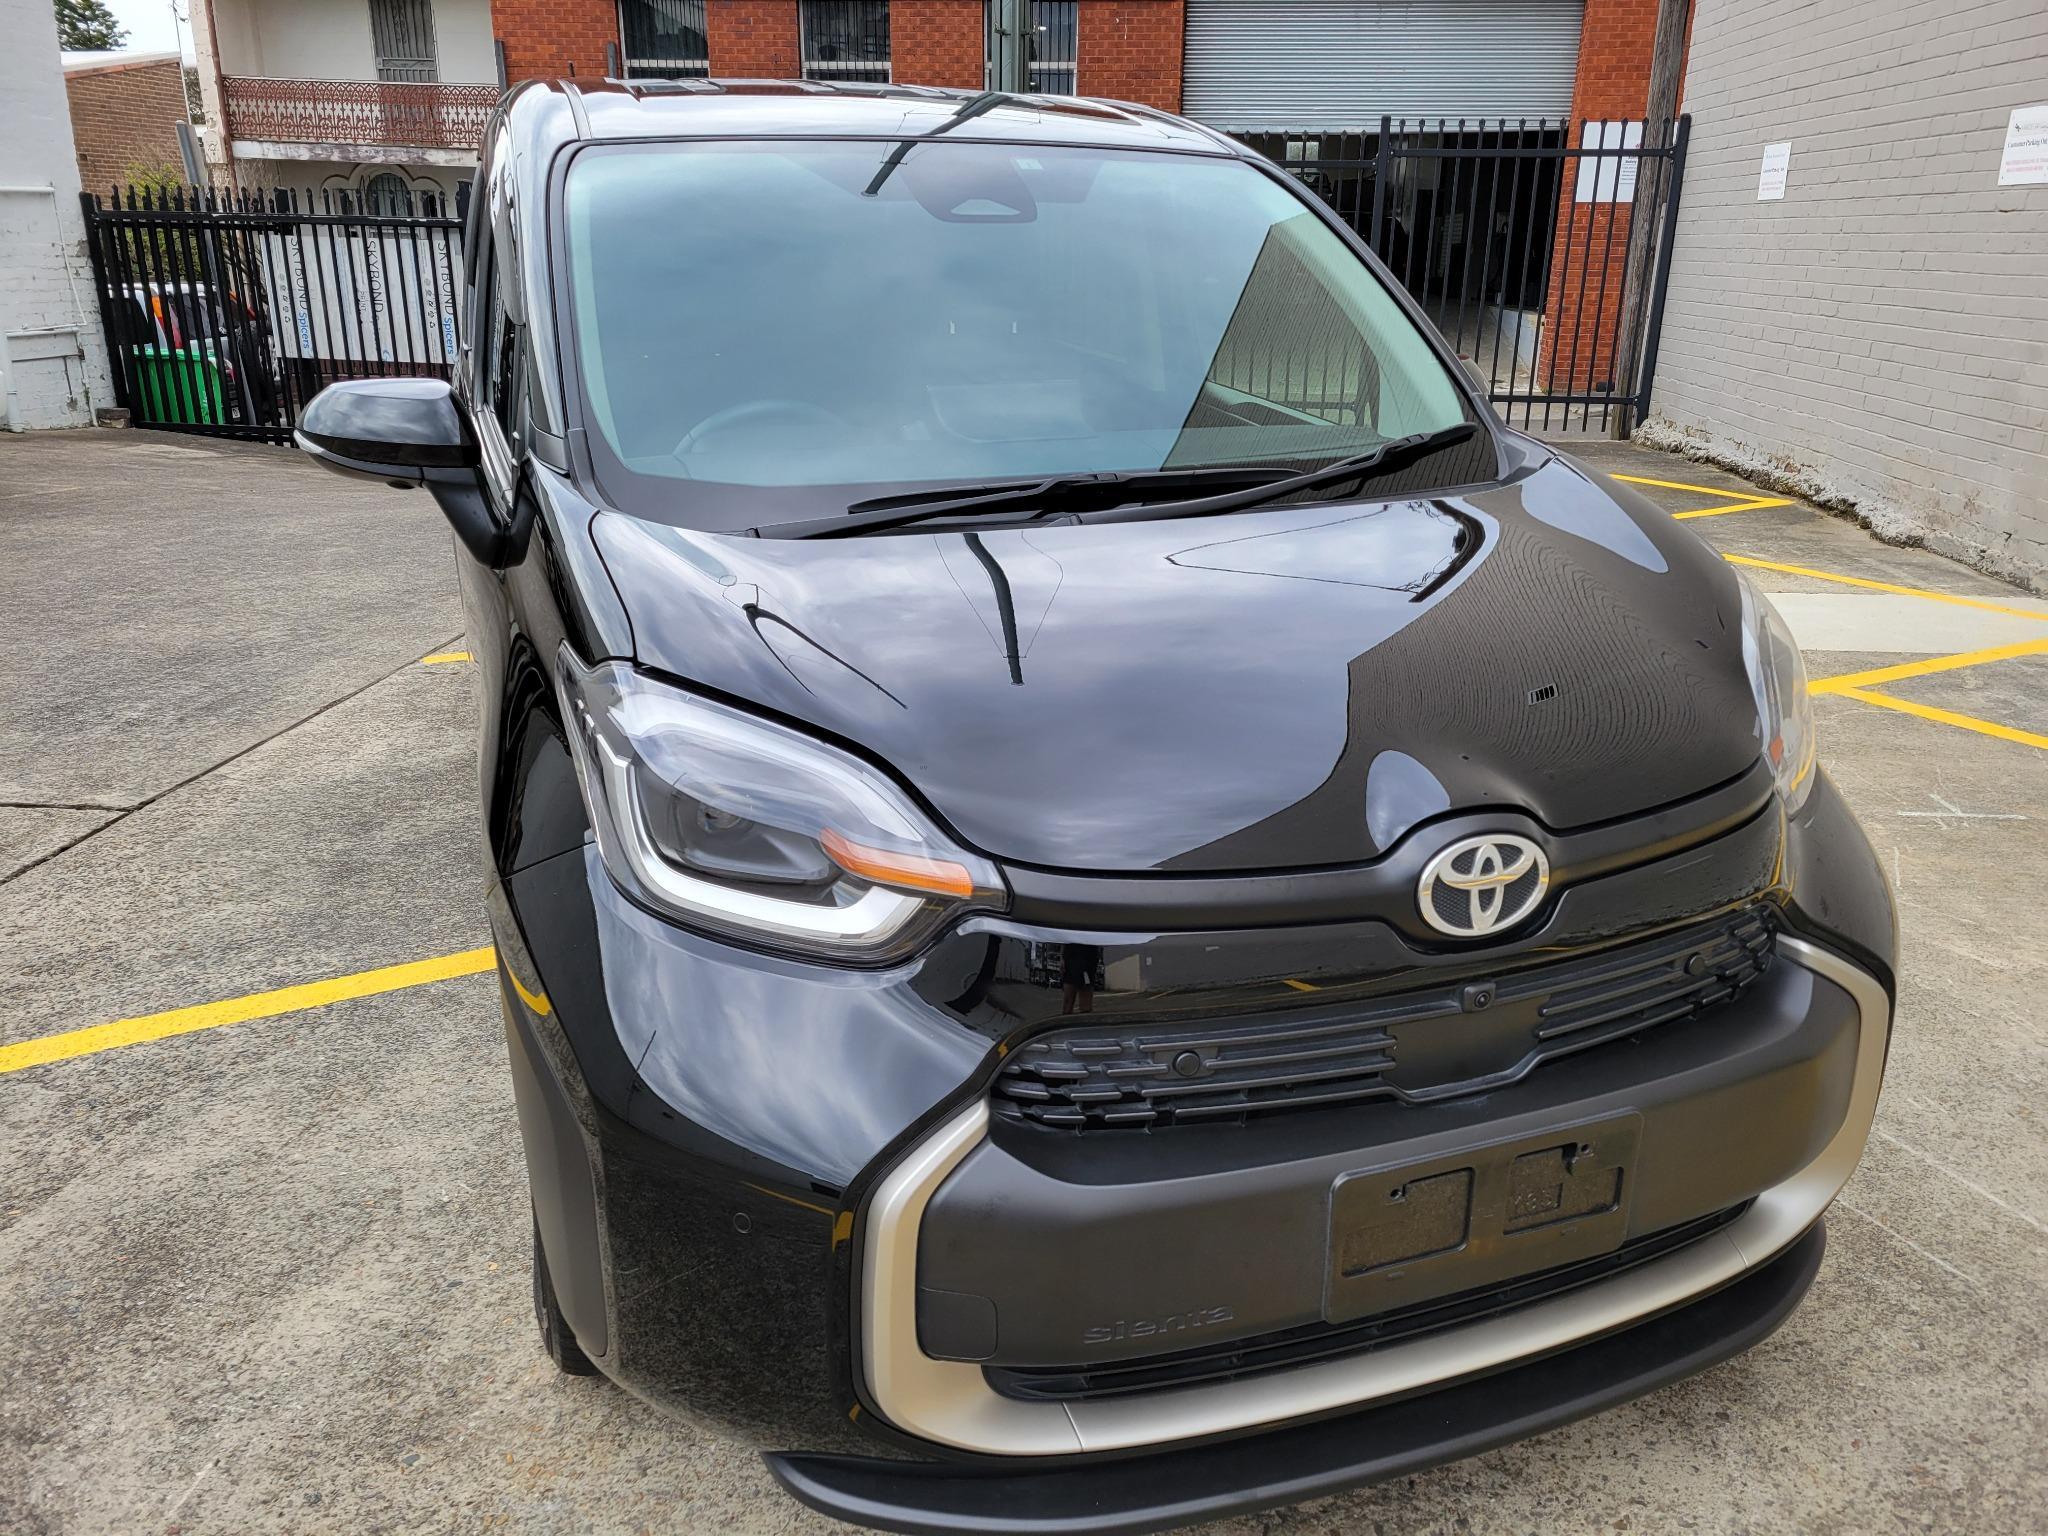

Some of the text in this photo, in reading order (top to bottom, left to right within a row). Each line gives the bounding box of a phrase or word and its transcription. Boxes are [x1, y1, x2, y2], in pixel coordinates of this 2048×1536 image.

[366, 240, 384, 313] SKYBOND
[298, 312, 310, 350] Spicers
[443, 317, 455, 355] Spicers
